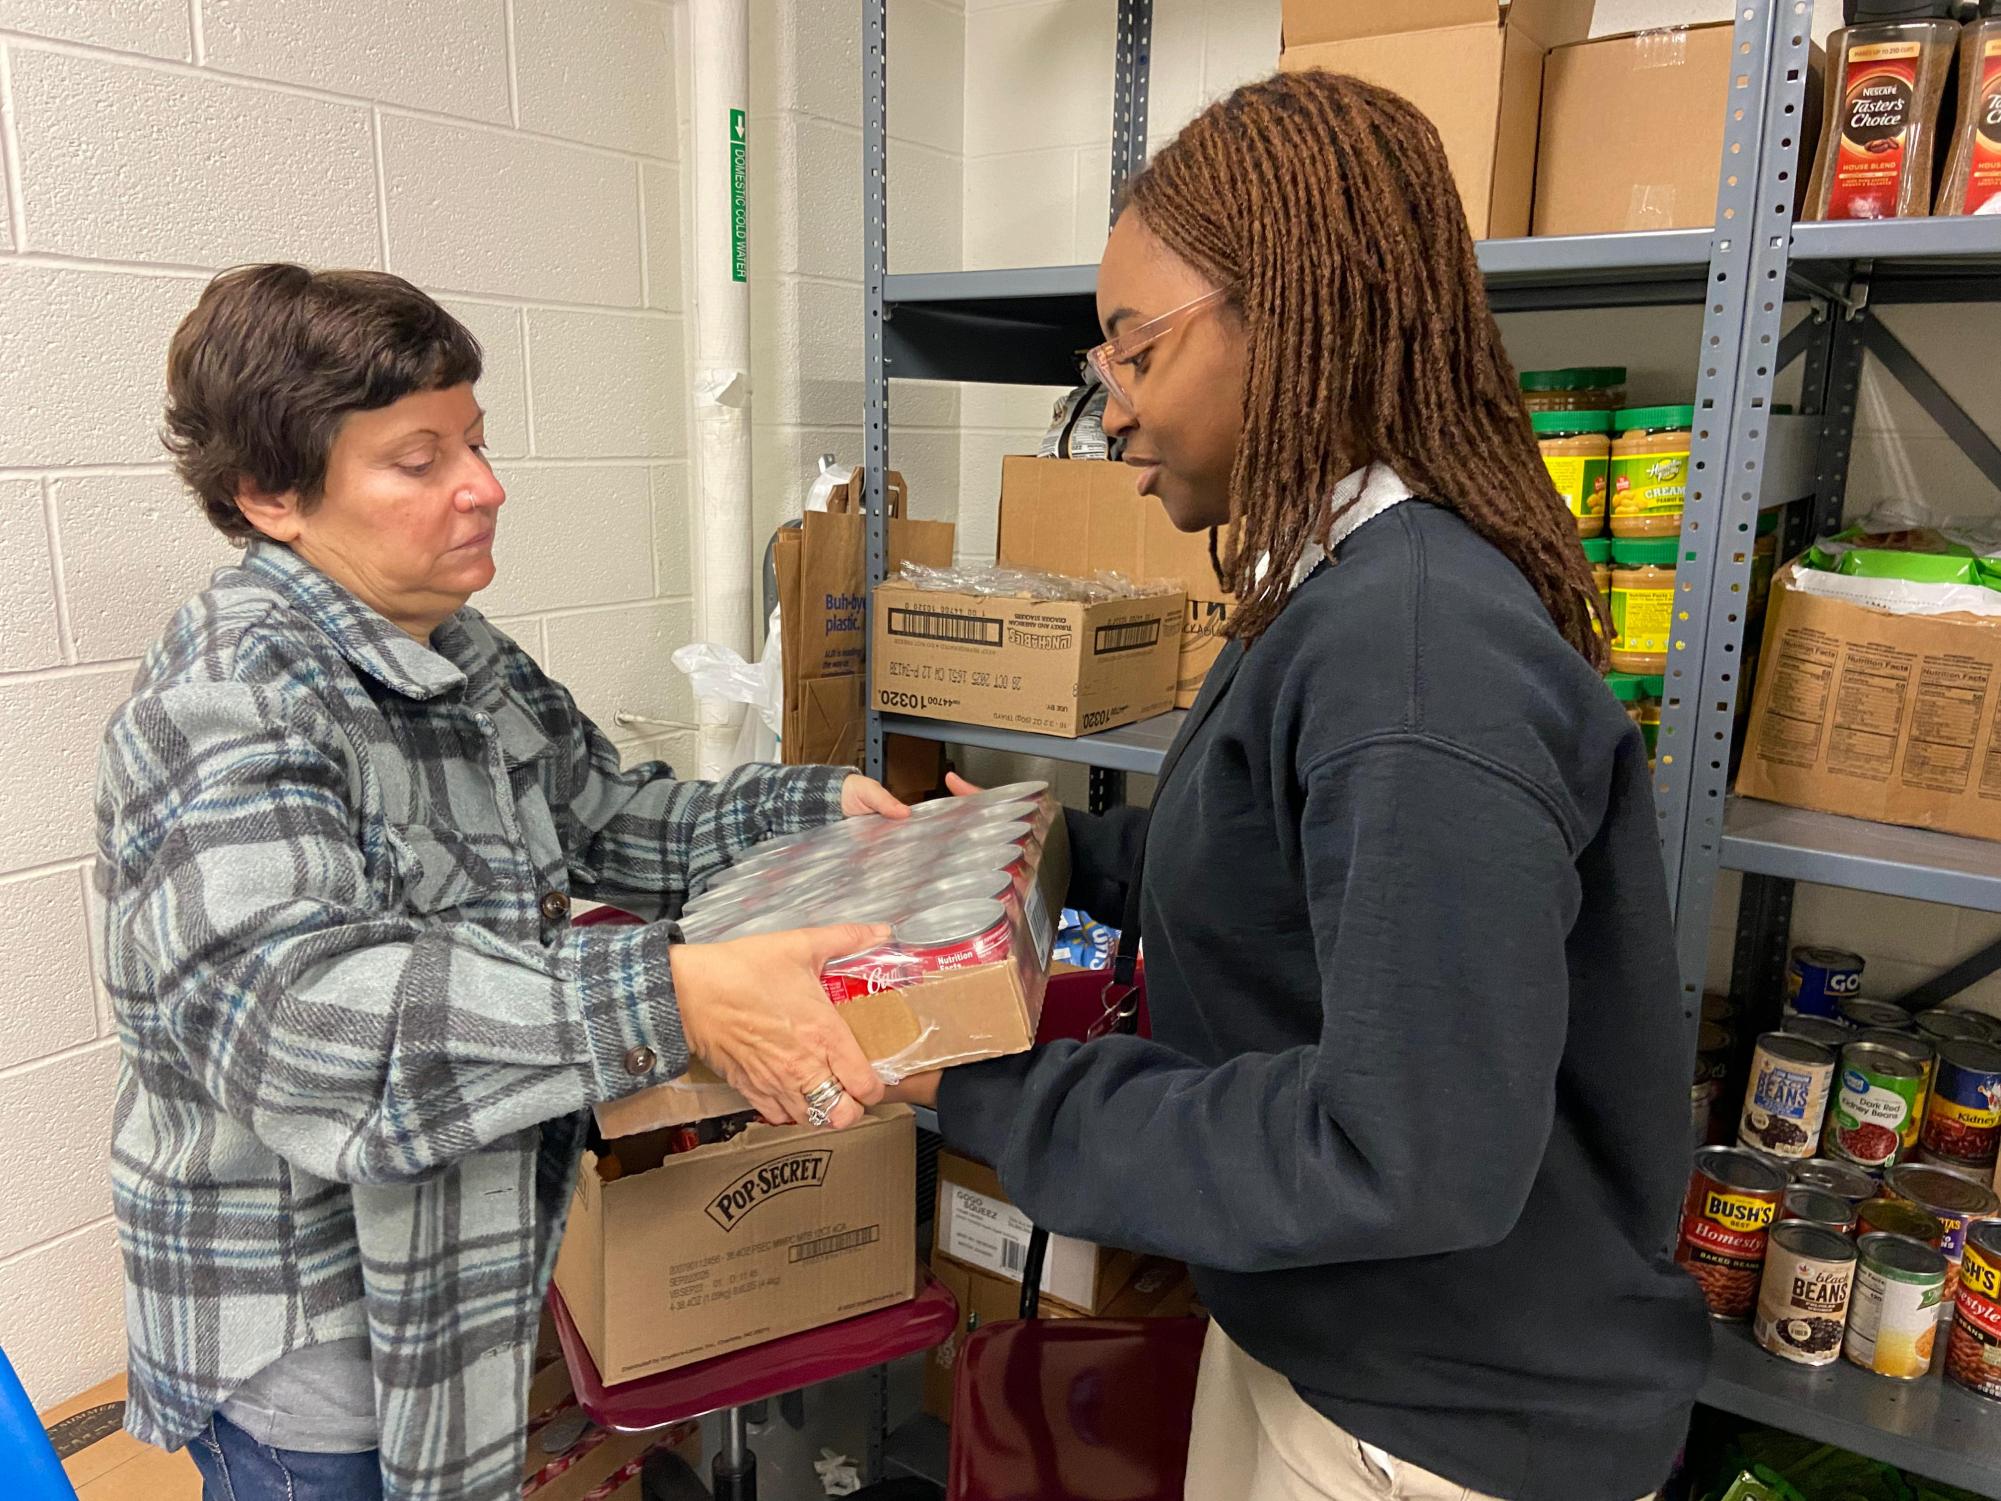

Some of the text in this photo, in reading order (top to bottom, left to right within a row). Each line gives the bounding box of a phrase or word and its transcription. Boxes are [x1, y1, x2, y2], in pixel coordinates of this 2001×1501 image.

[1852, 98, 1904, 114] Taster's
[1850, 112, 1900, 128] Choice
[1870, 162, 1896, 170] BLEND
[734, 150, 746, 278] DOMESTIC COLD WATER
[826, 614, 860, 638] plastic.
[1037, 622, 1050, 630] AND
[1051, 623, 1072, 631] TURKEY
[1008, 628, 1072, 651] LUNCHABLES
[1783, 640, 1814, 654] Nutrition
[1814, 646, 1836, 658] Facts
[1847, 655, 1909, 672] Nutrition Facts
[922, 665, 931, 681] 12
[993, 674, 1008, 689] OCT
[1922, 668, 1986, 682] Nutrition Facts
[880, 690, 953, 710] 10320 44700
[1083, 708, 1110, 728] 10320
[937, 951, 973, 965] Nutrition
[1758, 1076, 1808, 1107] BEANS
[1860, 1098, 1900, 1112] Dark Red
[1872, 1109, 1898, 1119] Beans
[1958, 1112, 1996, 1126] Kidney
[957, 1191, 983, 1206] GOGO
[964, 1201, 998, 1219] SQUEEZ
[1709, 1196, 1772, 1224] BUSH'S
[1700, 1252, 1730, 1265] BAKED
[1816, 1272, 1849, 1284] black
[1792, 1277, 1848, 1302] BEANS
